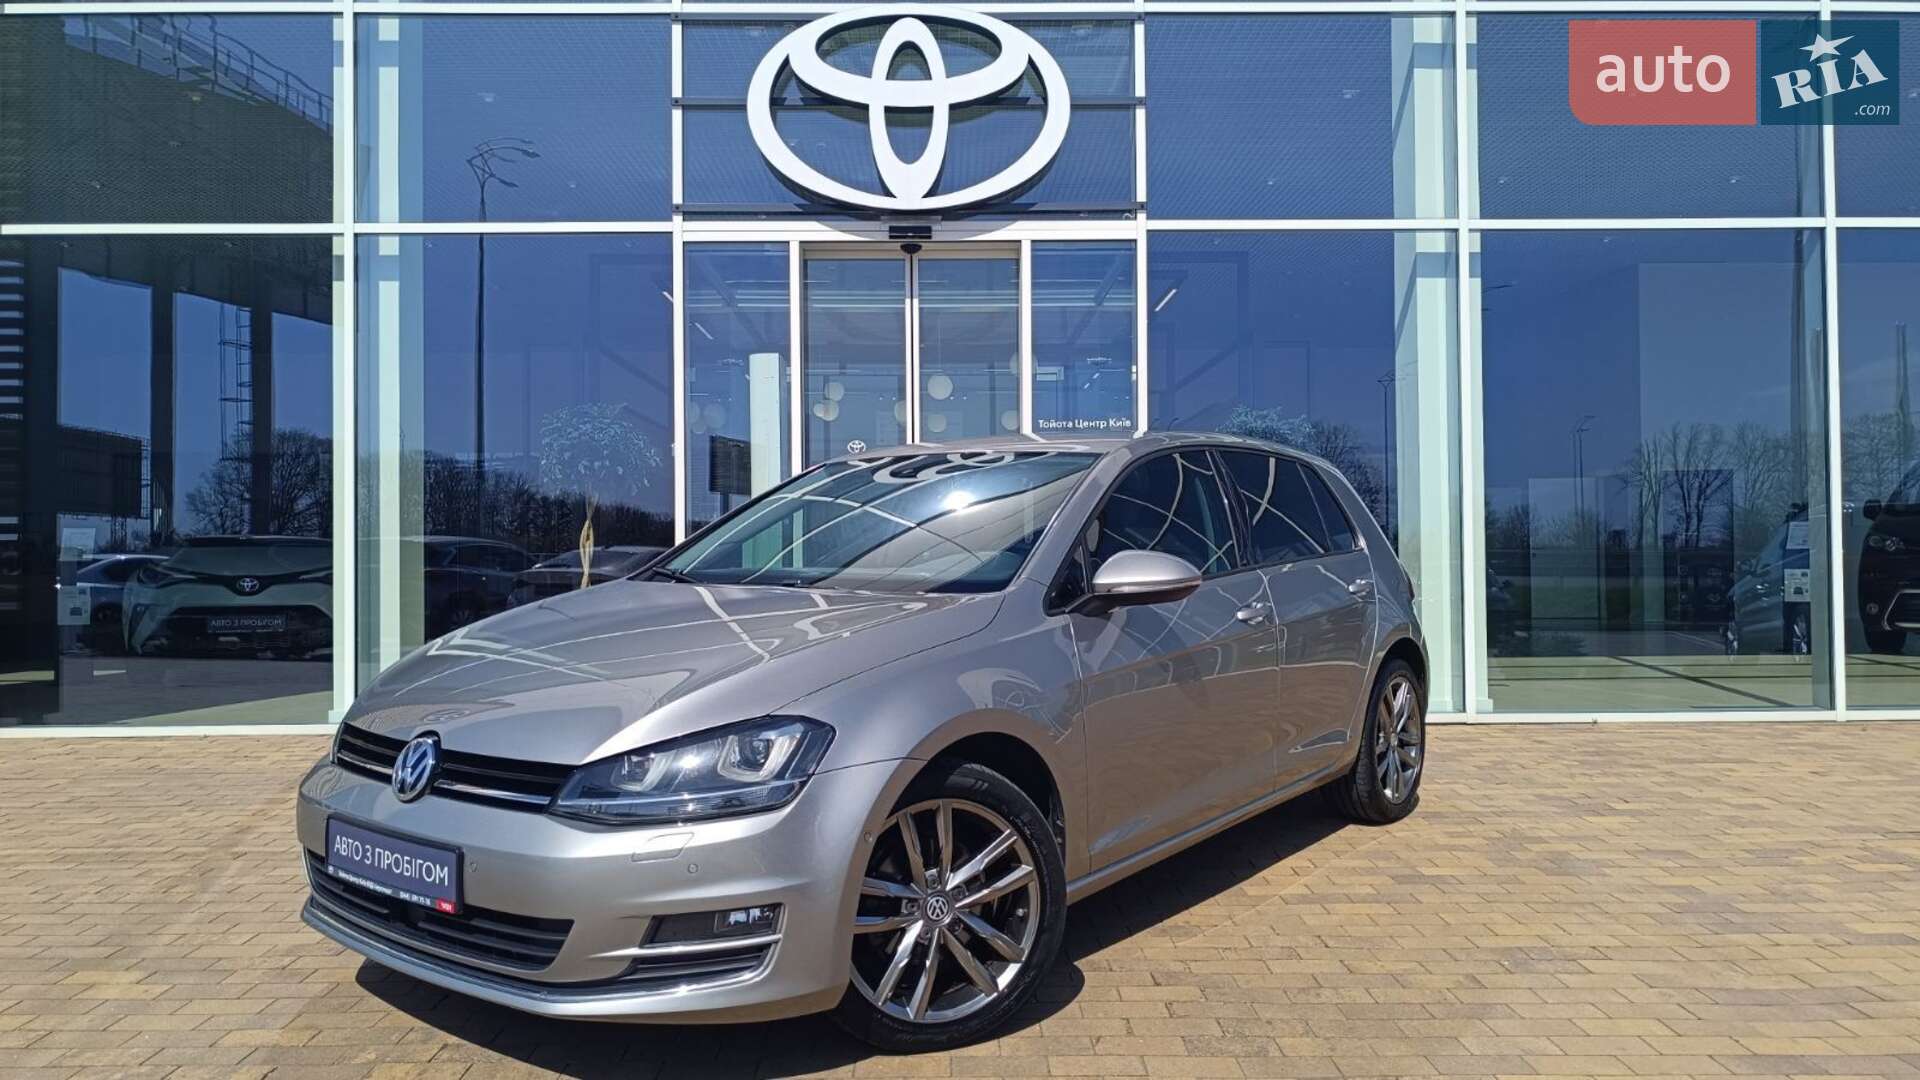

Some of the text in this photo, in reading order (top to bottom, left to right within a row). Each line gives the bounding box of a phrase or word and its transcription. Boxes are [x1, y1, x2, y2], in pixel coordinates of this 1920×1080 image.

[1038, 417, 1131, 429] Тойота Центр Київ
[334, 835, 362, 861] АВТО
[364, 844, 372, 865] З
[374, 847, 449, 887] ПРОБІГОМ
